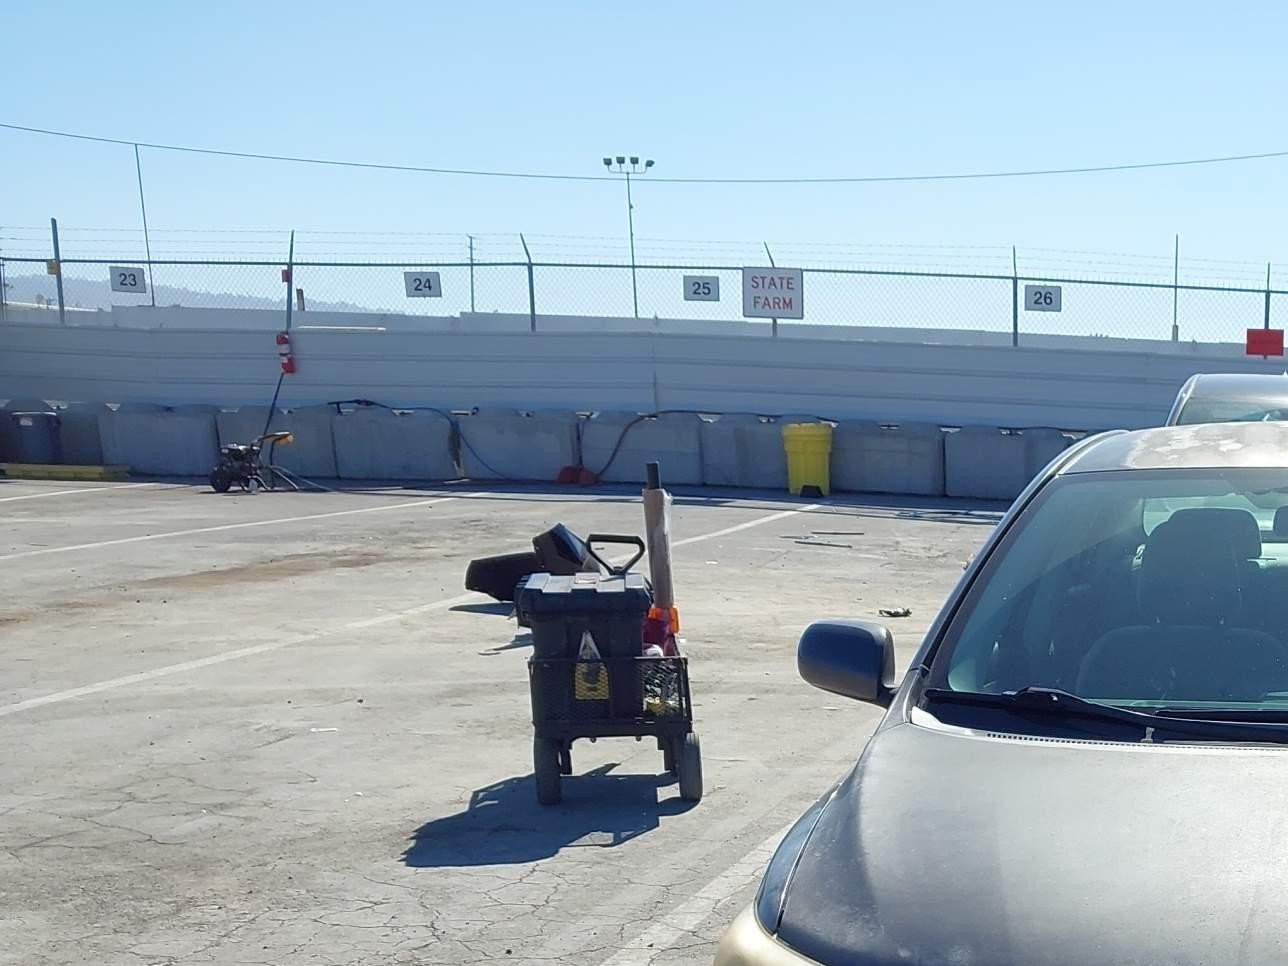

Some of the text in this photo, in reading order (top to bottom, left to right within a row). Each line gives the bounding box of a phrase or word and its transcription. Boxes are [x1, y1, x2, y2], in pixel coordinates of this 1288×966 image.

[119, 272, 137, 287] 23
[413, 277, 433, 292] 24
[751, 275, 795, 291] STATE
[692, 281, 712, 296] 25
[753, 295, 793, 311] FARM
[1033, 290, 1053, 306] 26
